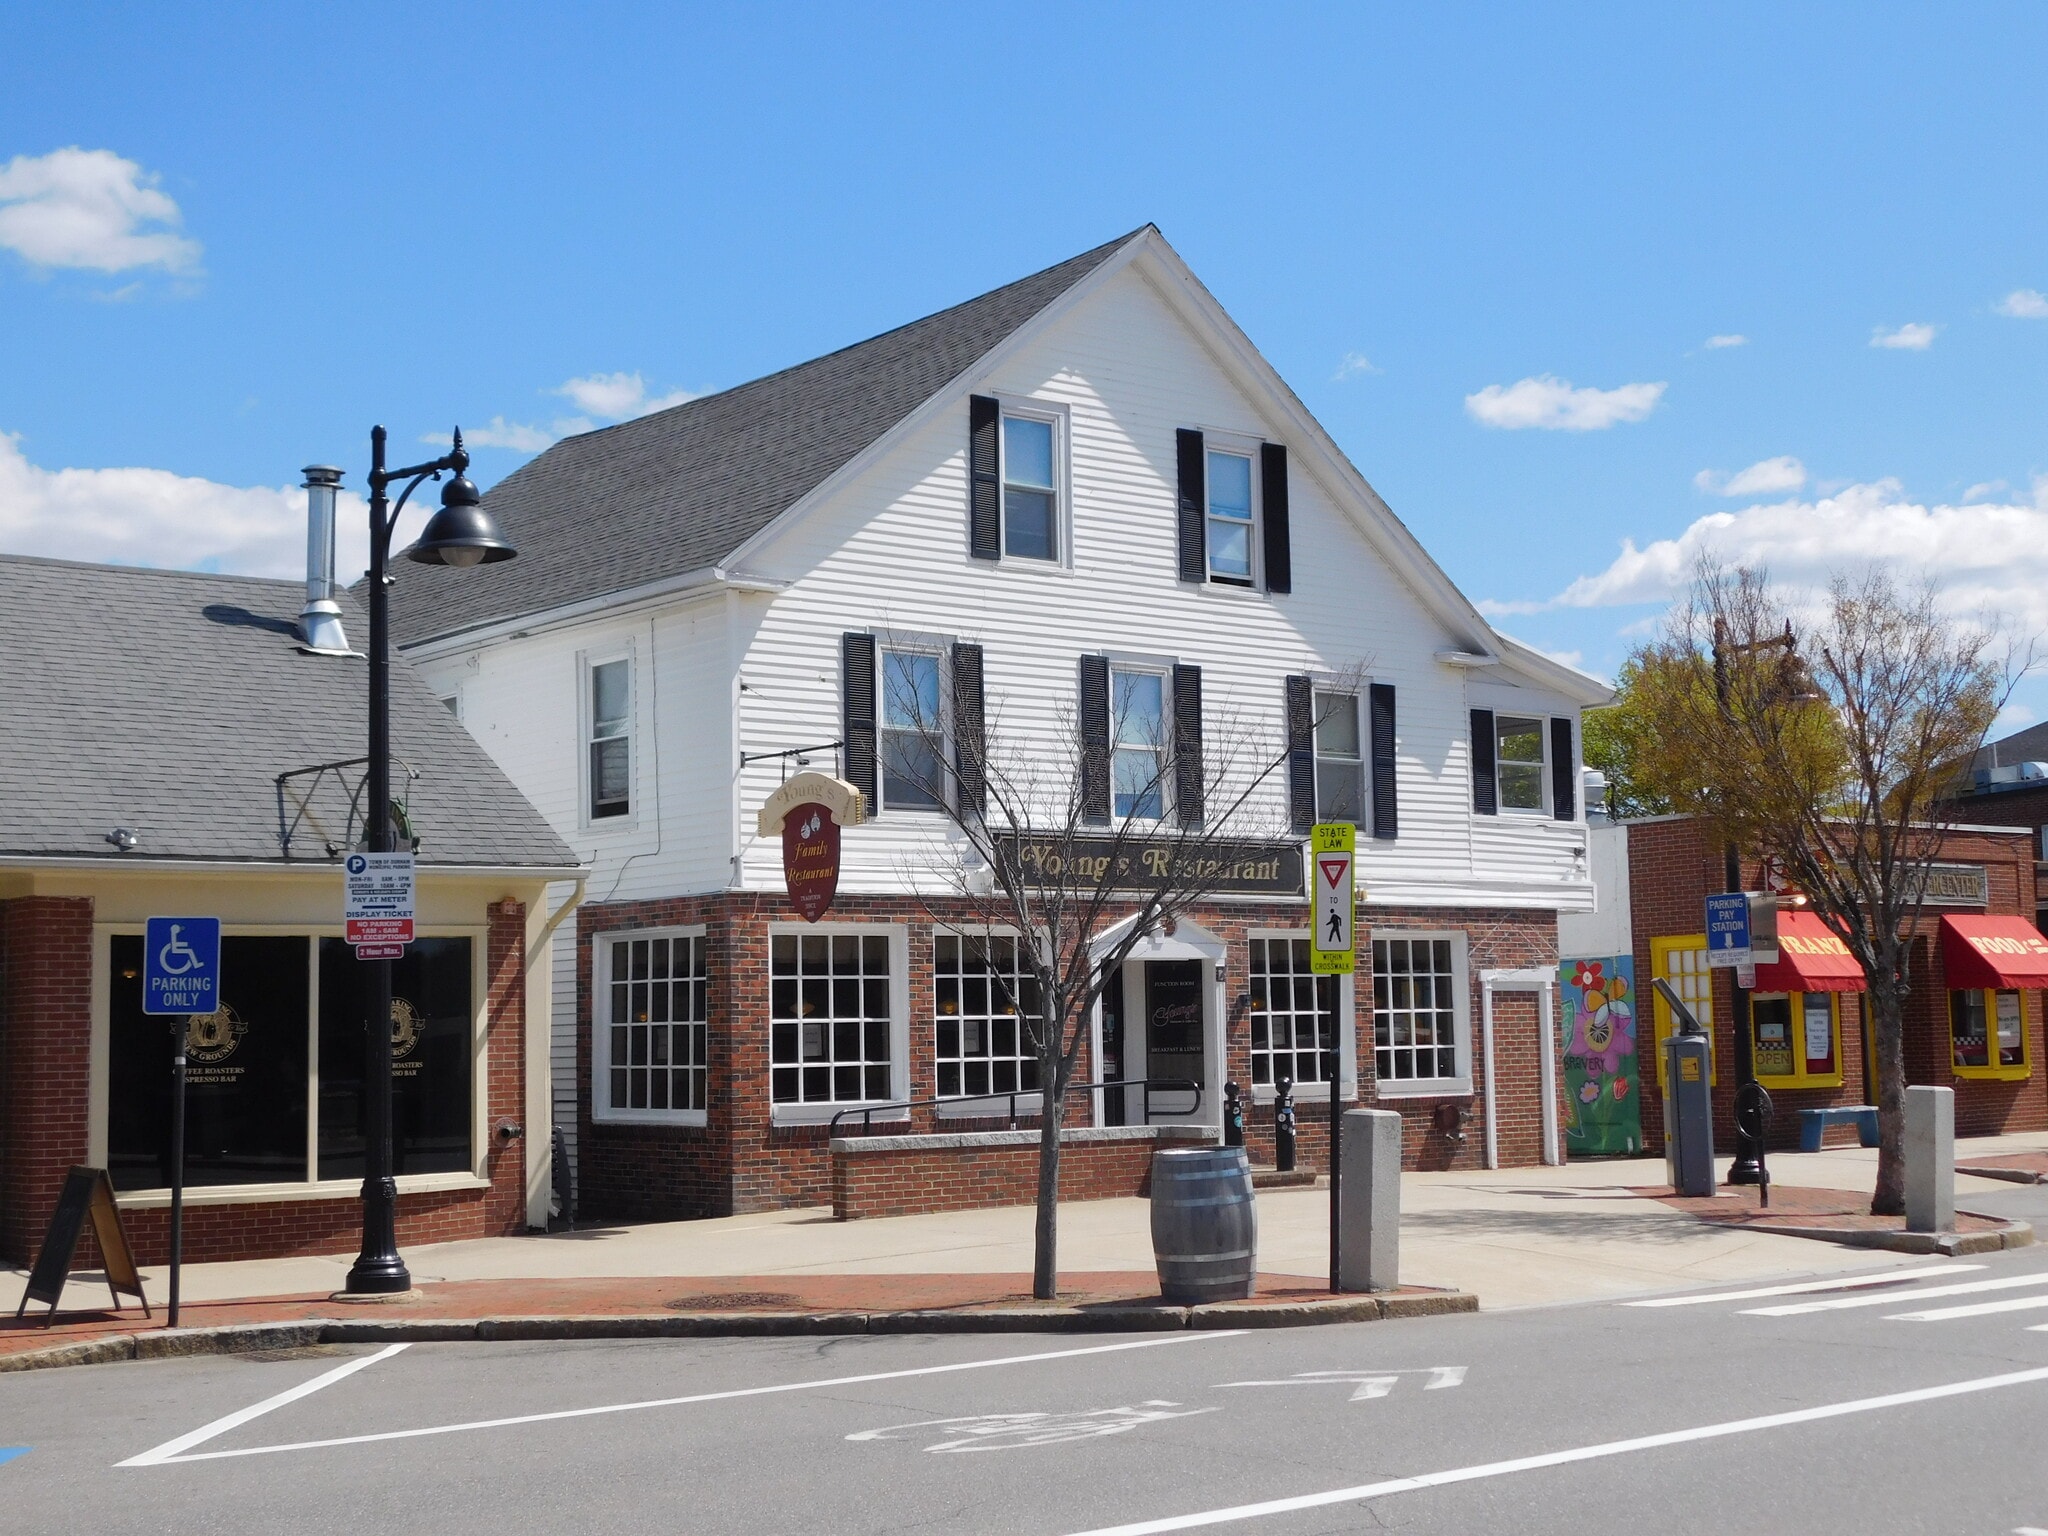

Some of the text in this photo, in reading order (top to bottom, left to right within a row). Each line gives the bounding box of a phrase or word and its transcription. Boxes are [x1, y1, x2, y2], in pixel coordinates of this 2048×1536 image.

[777, 780, 835, 804] Young's
[1320, 828, 1347, 837] STATE
[1324, 839, 1342, 848] LAW
[792, 840, 828, 863] Family
[1142, 848, 1280, 880] Restaurant
[788, 866, 834, 886] Restaurant
[1709, 899, 1743, 910] PARKING
[1719, 911, 1734, 920] PAY
[1711, 921, 1744, 932] STATION
[1969, 937, 2028, 955] FOOD
[1315, 962, 1350, 970] CROSSWALK
[152, 978, 211, 991] PARKING
[163, 993, 199, 1006] ONLY
[199, 1039, 236, 1060] GROUNDS
[1756, 1053, 1790, 1065] OPEN
[1692, 1062, 1697, 1071] 1
